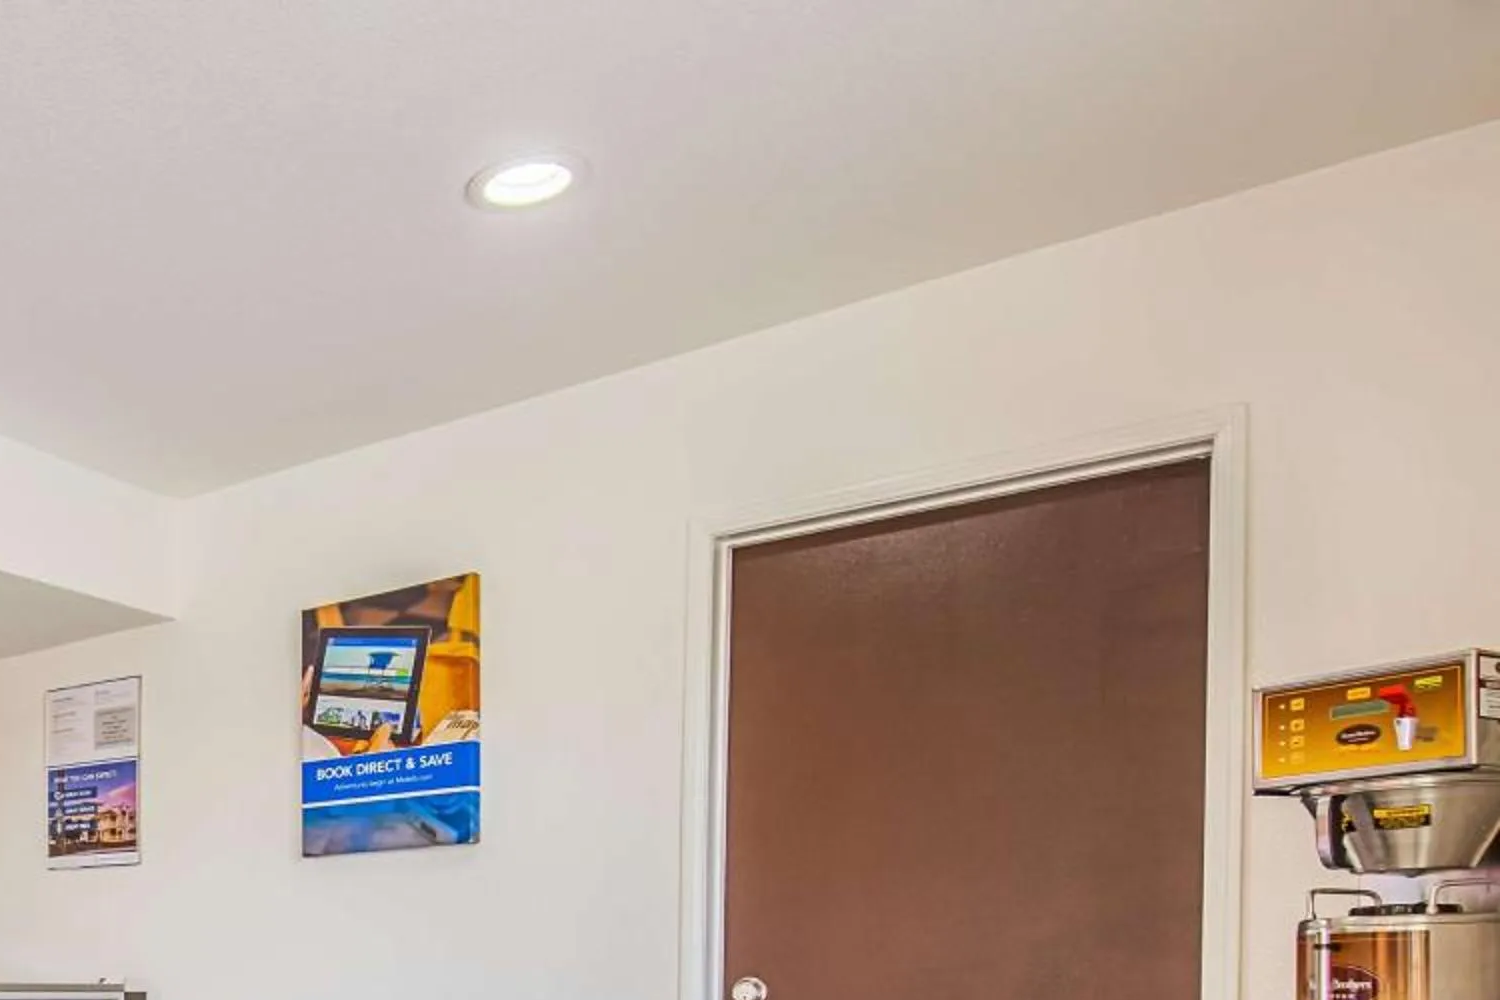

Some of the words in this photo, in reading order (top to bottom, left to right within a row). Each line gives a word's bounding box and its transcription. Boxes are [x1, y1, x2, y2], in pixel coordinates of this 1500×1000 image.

[316, 764, 353, 781] BOOK
[356, 757, 401, 776] DIRECT
[405, 757, 416, 770] &
[419, 752, 453, 769] SAVE
